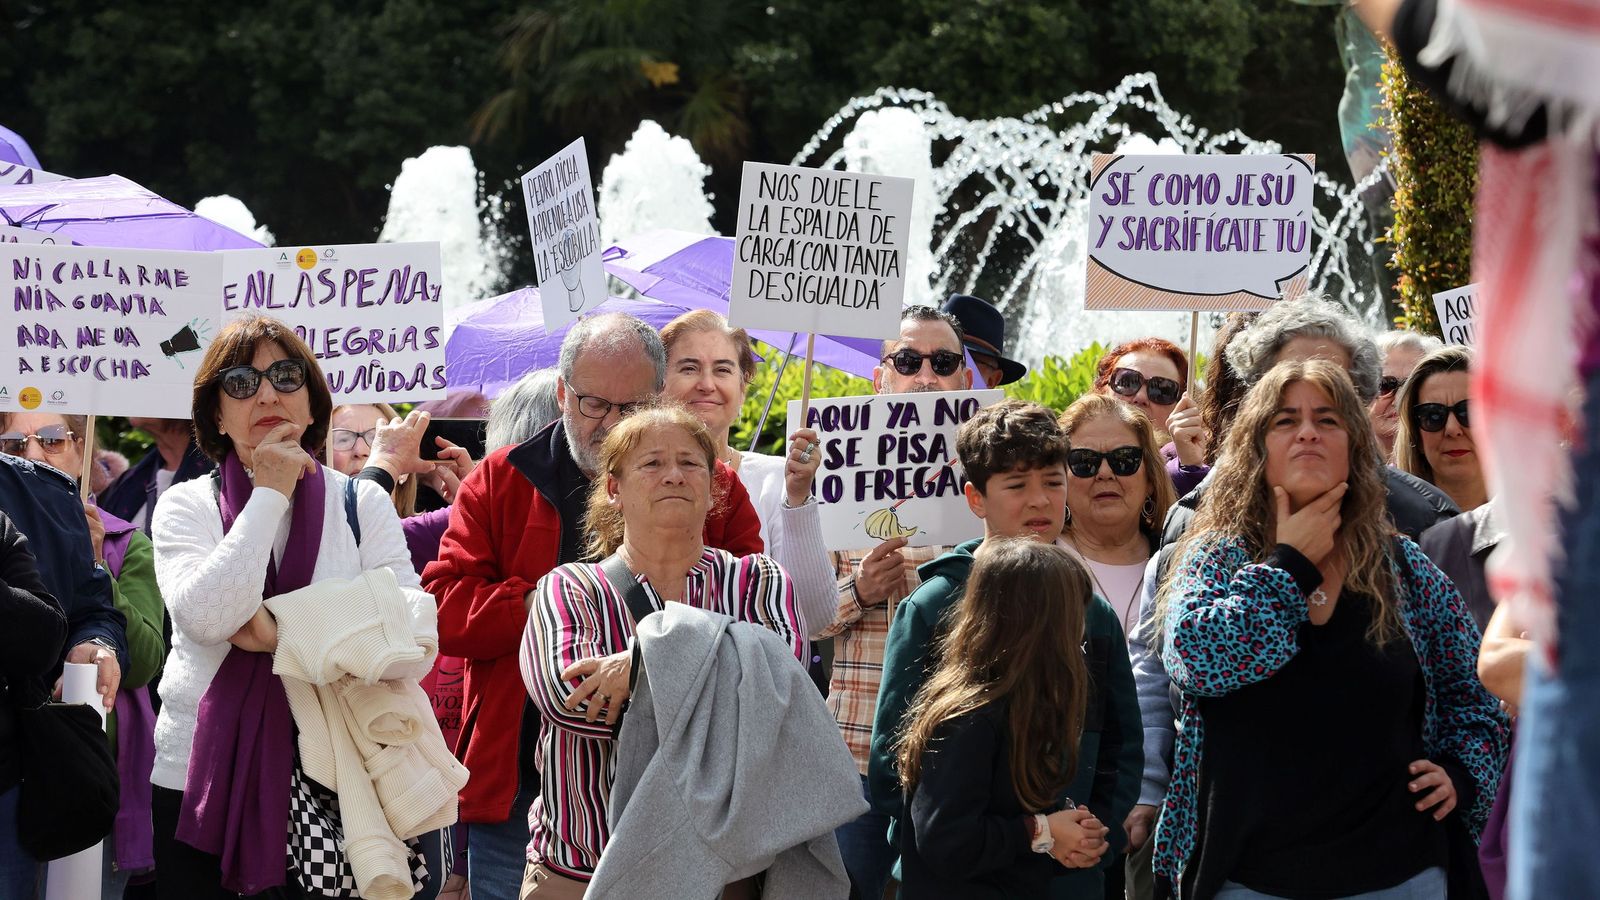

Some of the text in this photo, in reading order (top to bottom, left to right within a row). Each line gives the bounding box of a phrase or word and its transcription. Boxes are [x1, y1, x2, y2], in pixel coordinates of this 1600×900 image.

[556, 155, 580, 193] PICHA
[759, 171, 882, 211] NOS DUELE
[1102, 163, 1295, 207] SÉ COMO JESÚ
[532, 201, 568, 246] APRENDE
[748, 203, 896, 245] LA ESPALDA DE
[1095, 214, 1114, 249] Y
[1272, 210, 1307, 253] TÚ
[53, 259, 190, 289] CALLARME
[537, 249, 551, 283] LA
[740, 235, 899, 278] CARGÁ CON TANTA
[748, 269, 886, 310] DESIGUALDÁ
[77, 326, 106, 349] ME
[806, 397, 980, 432] AQUÍ YA NO
[823, 431, 949, 471] SE PISA
[854, 465, 966, 502] FREGA
